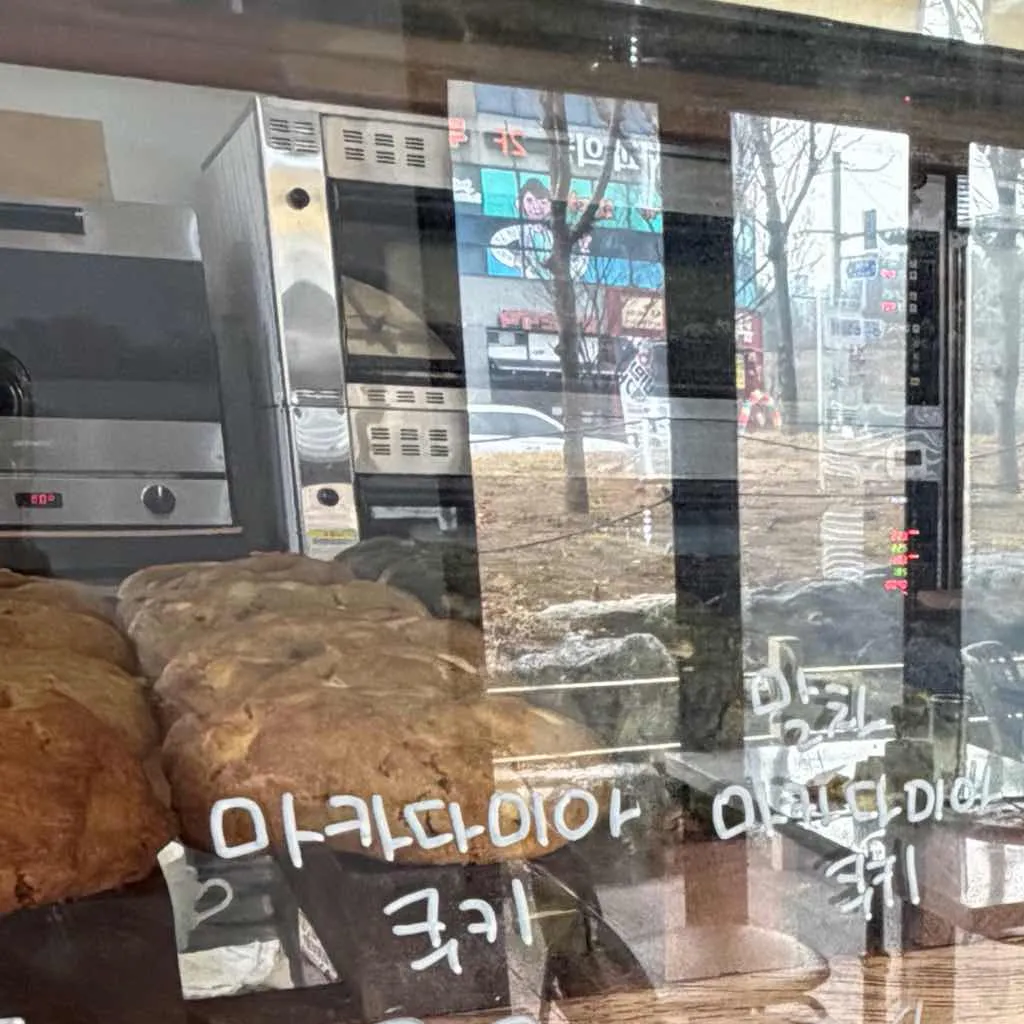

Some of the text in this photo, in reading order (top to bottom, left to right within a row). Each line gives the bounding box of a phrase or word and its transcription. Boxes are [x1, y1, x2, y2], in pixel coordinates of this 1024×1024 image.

[210, 787, 641, 868] 마카다미아
[712, 773, 998, 840] 마카다미아
[825, 843, 921, 920] 쿠키
[382, 878, 533, 975] 쿠키
